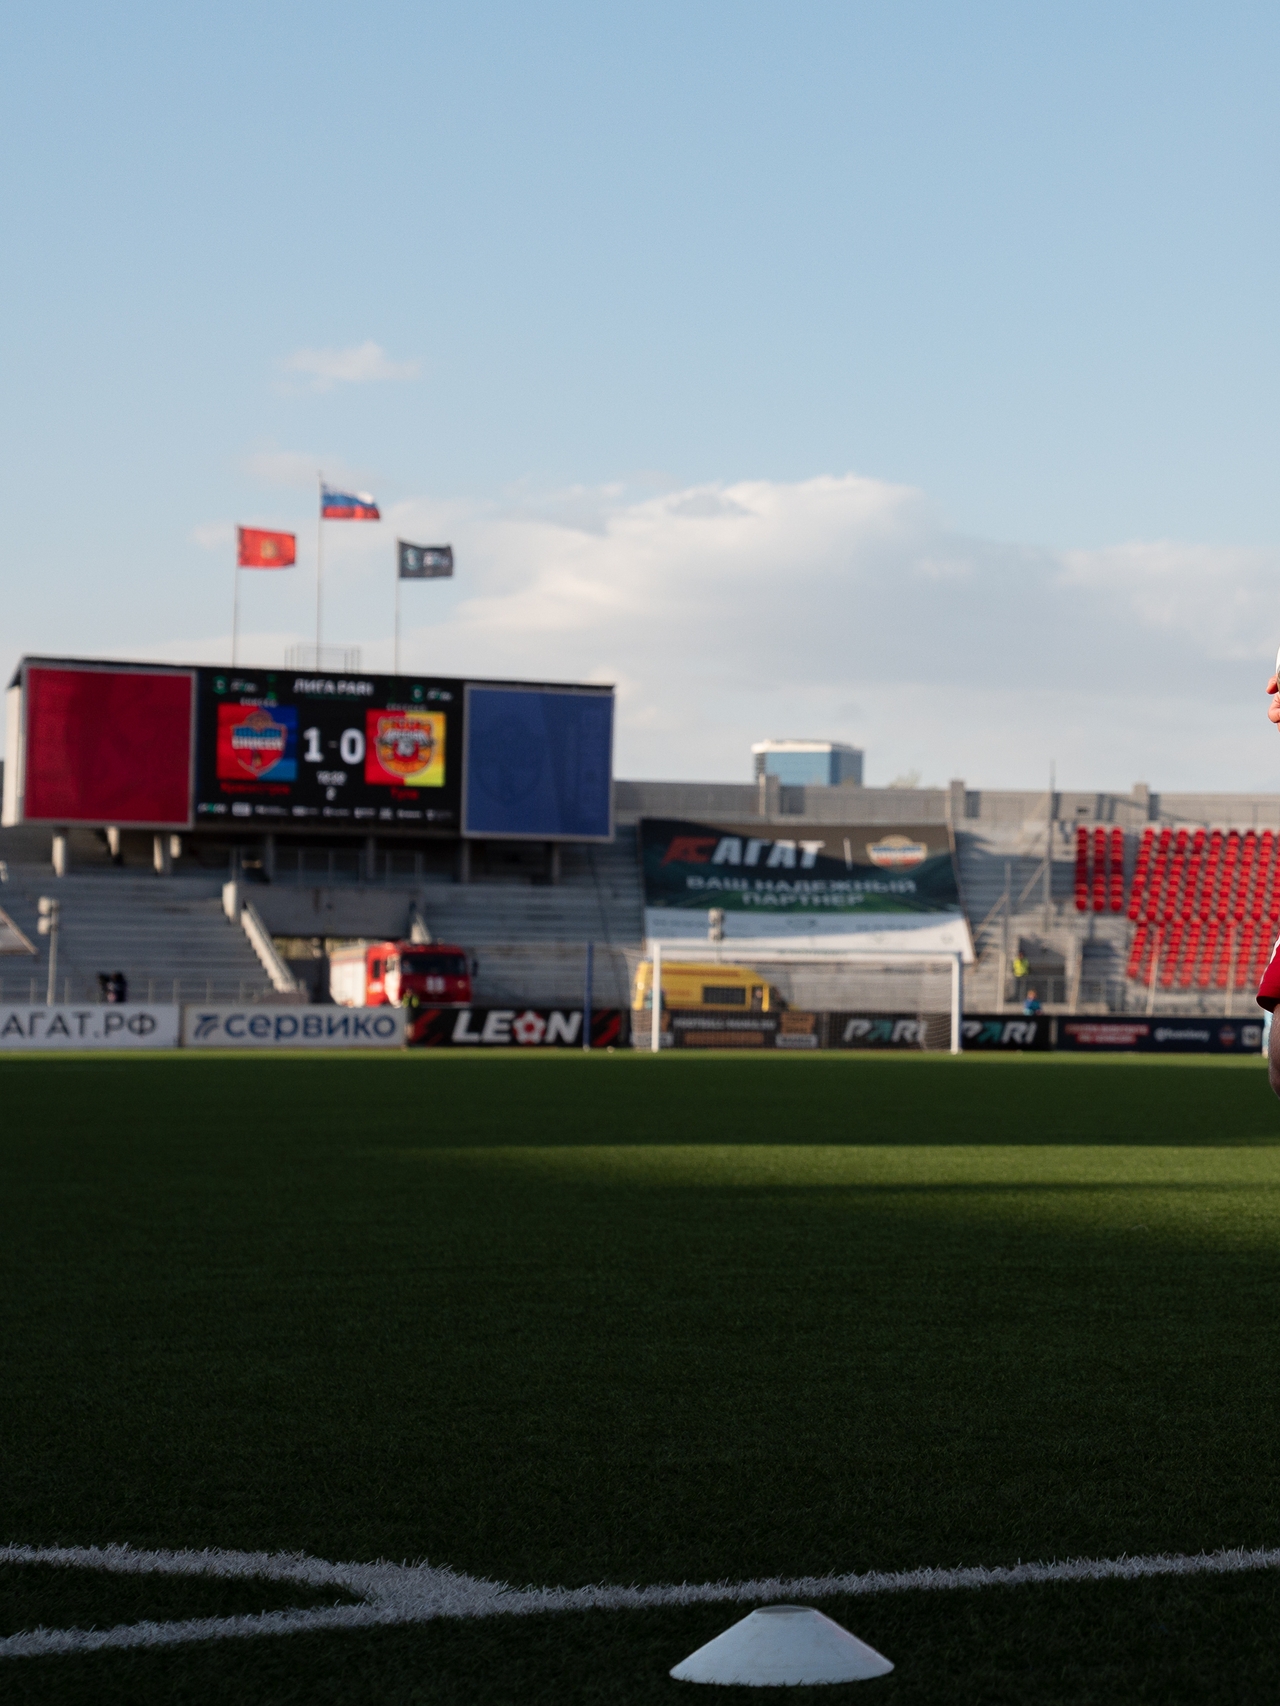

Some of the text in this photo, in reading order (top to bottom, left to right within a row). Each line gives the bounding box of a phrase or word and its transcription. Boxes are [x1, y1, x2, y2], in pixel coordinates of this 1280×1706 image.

[303, 727, 324, 763] 1
[340, 728, 365, 764] 0
[710, 837, 825, 869] АГАТ
[686, 875, 748, 891] ВАШ
[1, 1011, 158, 1037] АГАТ.РФ
[224, 1012, 397, 1040] сервико
[452, 1009, 583, 1044] LEON
[843, 1018, 929, 1043] PARI
